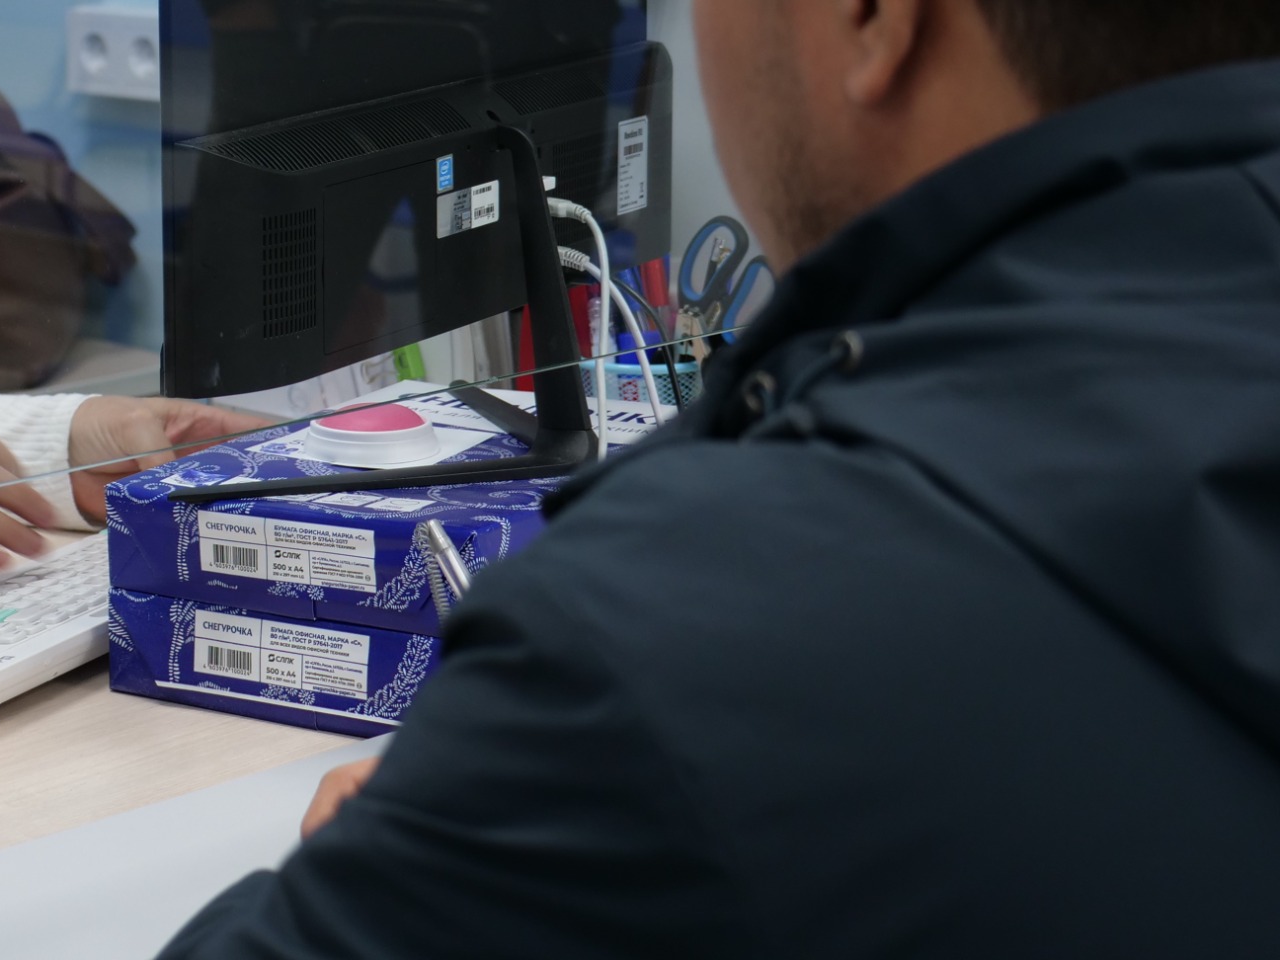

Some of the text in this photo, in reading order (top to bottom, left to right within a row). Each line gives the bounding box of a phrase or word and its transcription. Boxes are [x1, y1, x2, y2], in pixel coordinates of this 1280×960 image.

[205, 521, 257, 535] СНЕГУРОЧКА
[273, 524, 298, 533] БУМАГА
[298, 527, 331, 537] ОФИСНАЯ,
[331, 531, 354, 539] МАРКА
[272, 562, 287, 571] 500
[202, 620, 253, 637] СНЕГУРОЧКА
[270, 626, 294, 635] БУМАГА
[294, 630, 327, 641] ОФИСНАЯ,
[327, 636, 350, 644] МАРКА
[292, 636, 307, 644] ГОСТ
[312, 639, 344, 649] 57641-2017
[266, 666, 280, 675] 500
